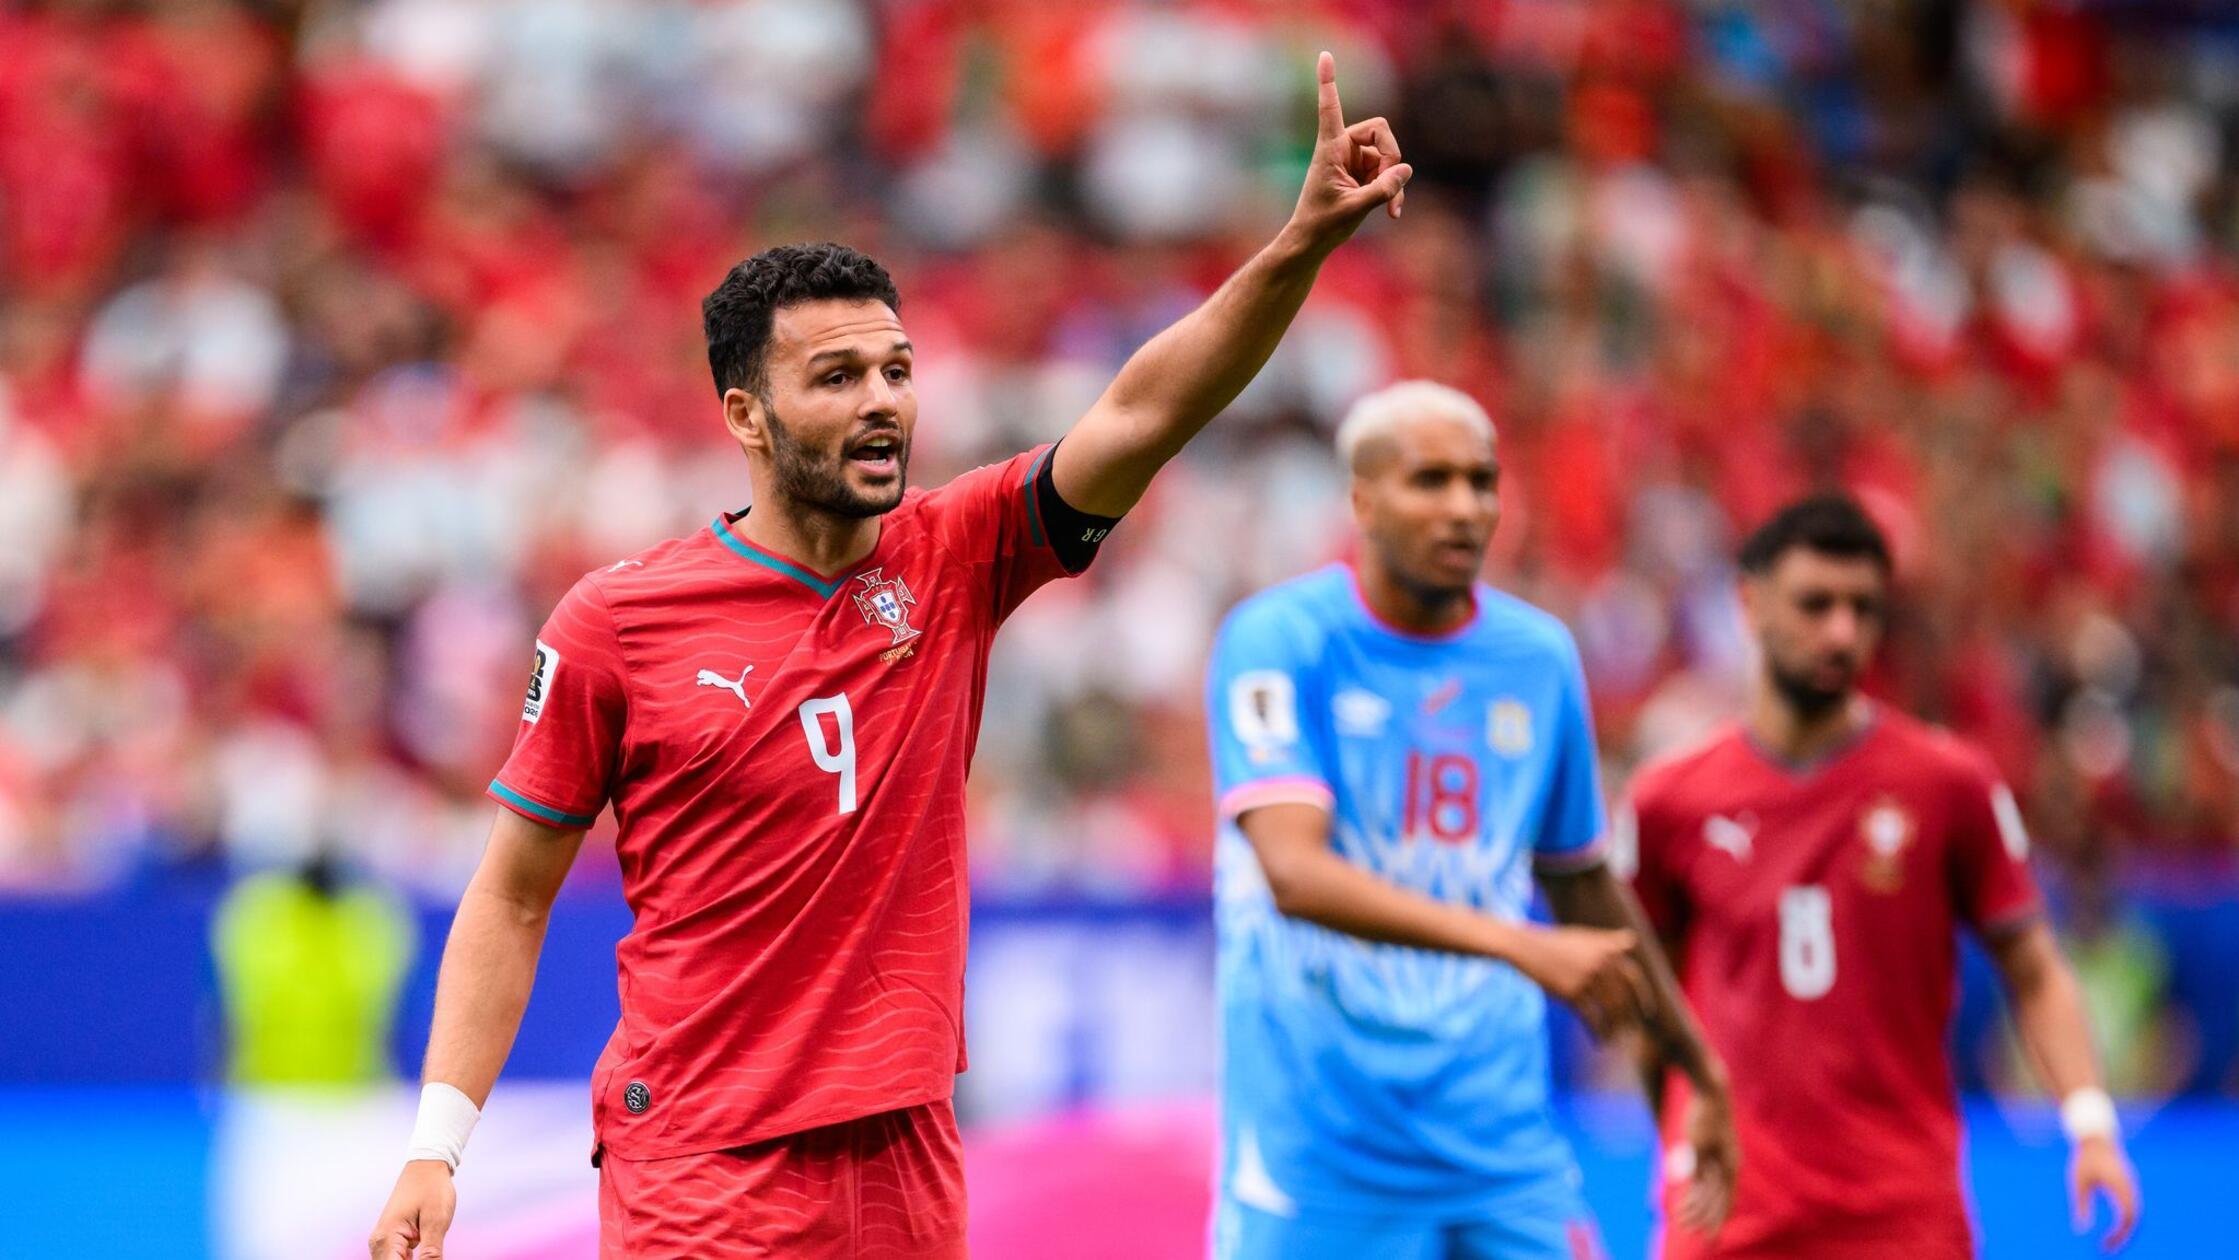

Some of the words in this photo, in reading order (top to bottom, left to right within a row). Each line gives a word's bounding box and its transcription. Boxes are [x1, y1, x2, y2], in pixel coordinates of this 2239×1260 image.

[798, 691, 857, 815] 9
[1404, 749, 1478, 843] 18
[1778, 884, 1837, 1000] 8
